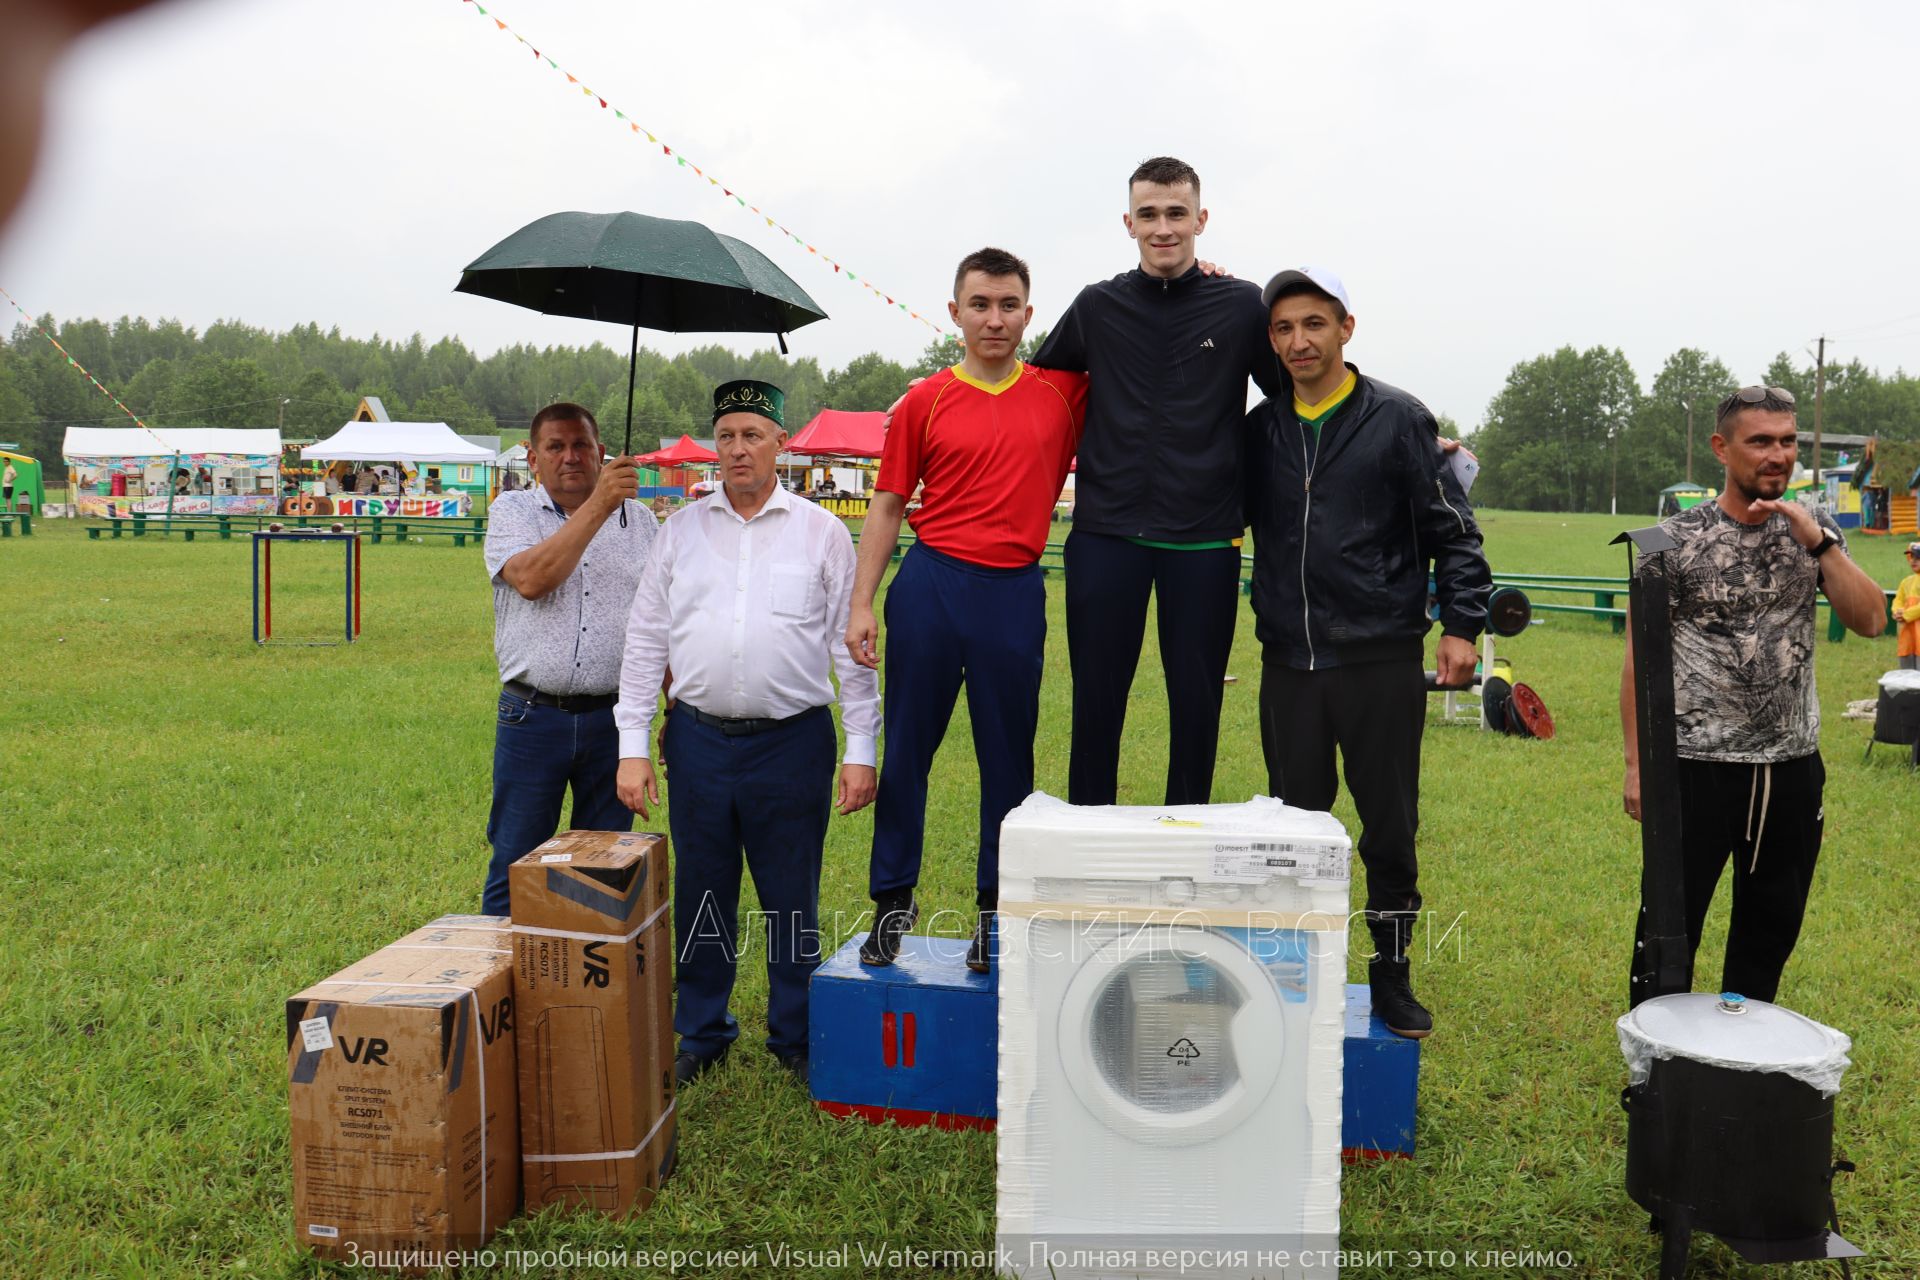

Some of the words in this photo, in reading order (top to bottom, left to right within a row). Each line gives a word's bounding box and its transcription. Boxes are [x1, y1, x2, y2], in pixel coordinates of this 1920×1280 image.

[338, 499, 459, 516] ИГРУШКИ
[819, 499, 869, 516] ШАШ
[540, 942, 549, 978] RCS071
[583, 941, 609, 988] VR
[480, 996, 513, 1045] VR
[337, 1036, 390, 1066] VR
[347, 1107, 384, 1119] RCS071
